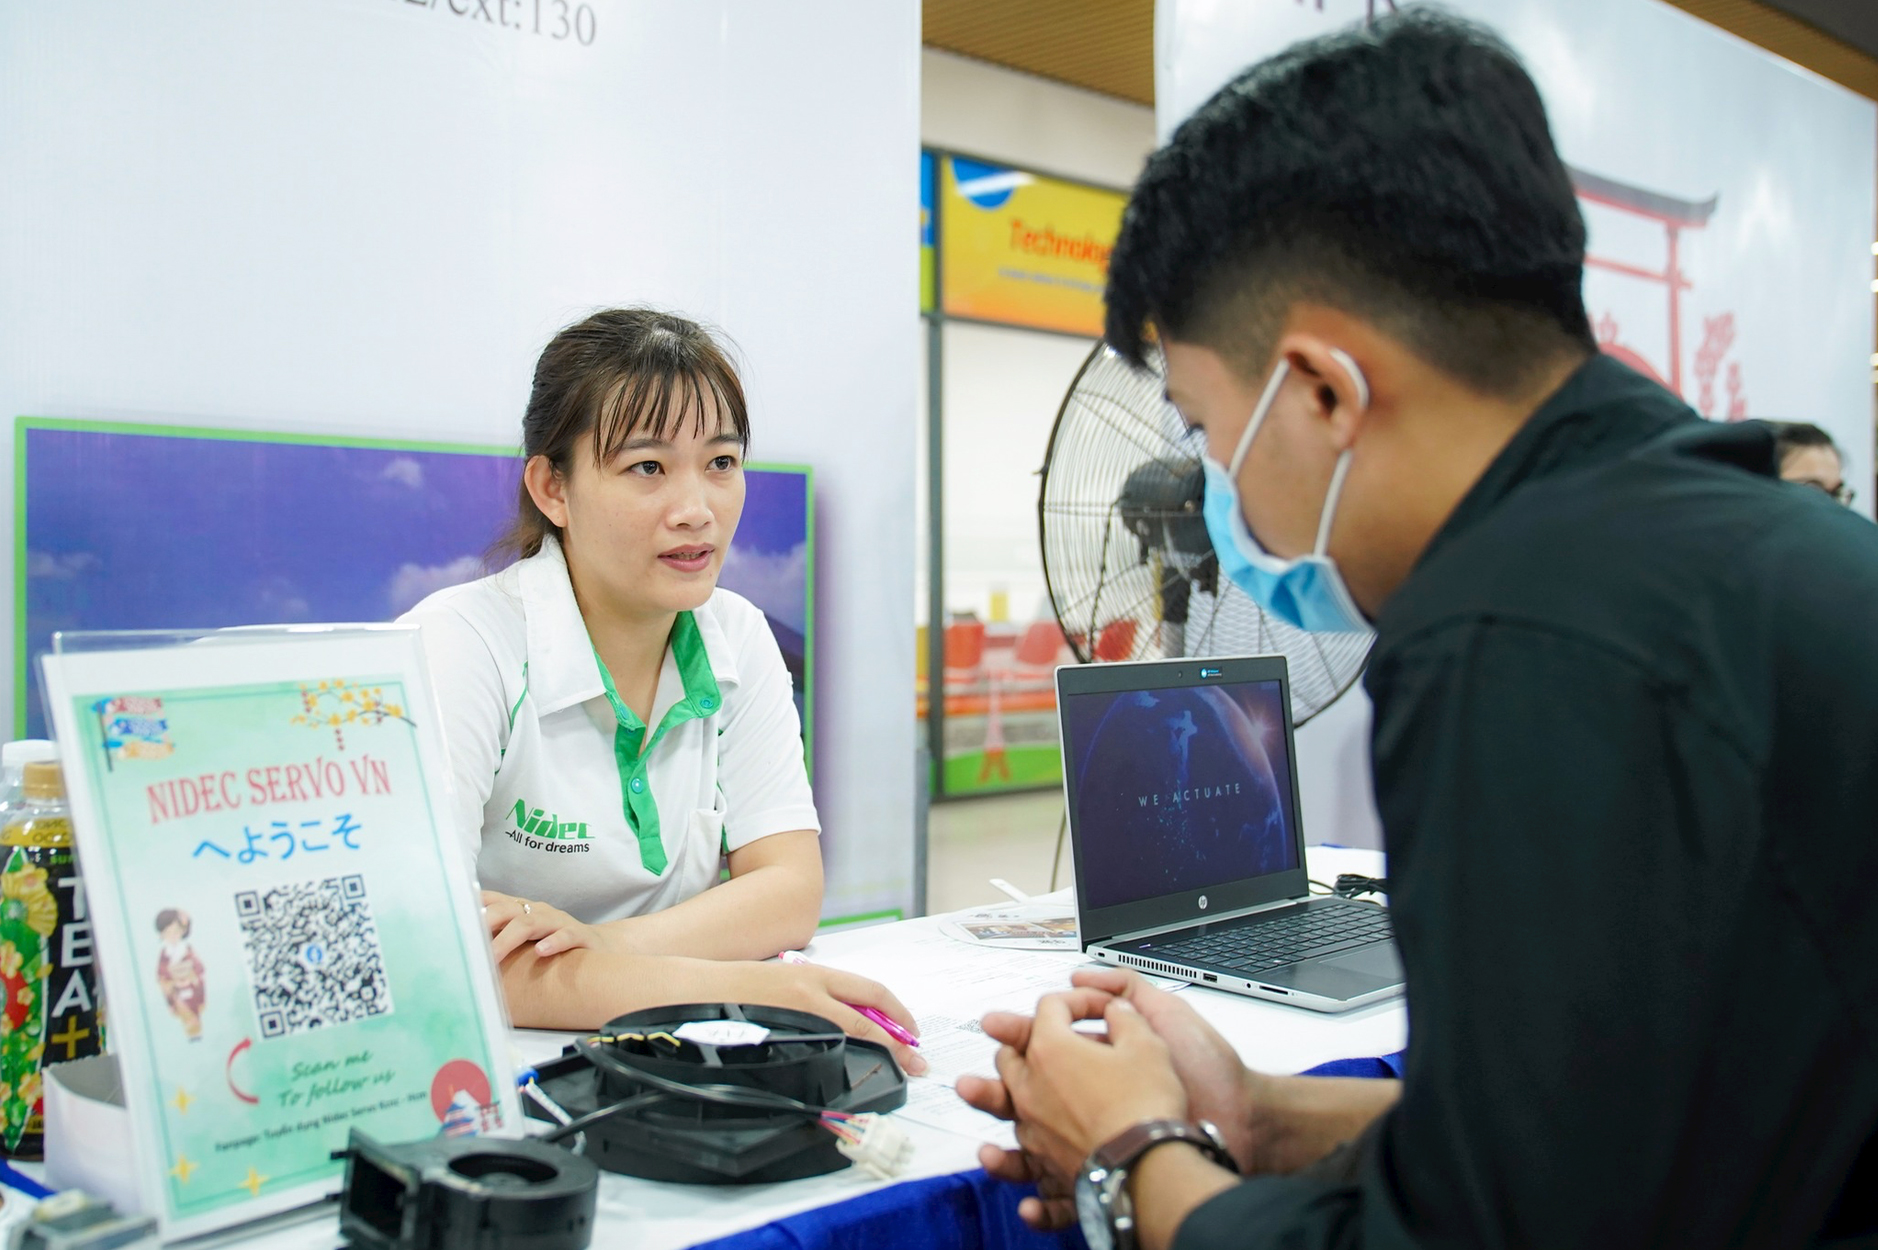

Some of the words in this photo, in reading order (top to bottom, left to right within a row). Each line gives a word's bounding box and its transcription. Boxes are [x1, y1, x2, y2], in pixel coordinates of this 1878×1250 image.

[147, 771, 241, 824] NIDEC
[246, 756, 345, 806] SERVO
[349, 754, 391, 796] VN
[1138, 794, 1159, 807] WE
[1172, 783, 1241, 803] ACTUATE
[192, 813, 362, 864] へようこそ
[505, 798, 596, 840] Nidec
[524, 836, 544, 850] for
[545, 841, 590, 854] dreams
[290, 1059, 340, 1082] Scan
[344, 1049, 374, 1067] me
[278, 1087, 304, 1107] To
[305, 1073, 368, 1108] follow
[372, 1068, 397, 1088] us
